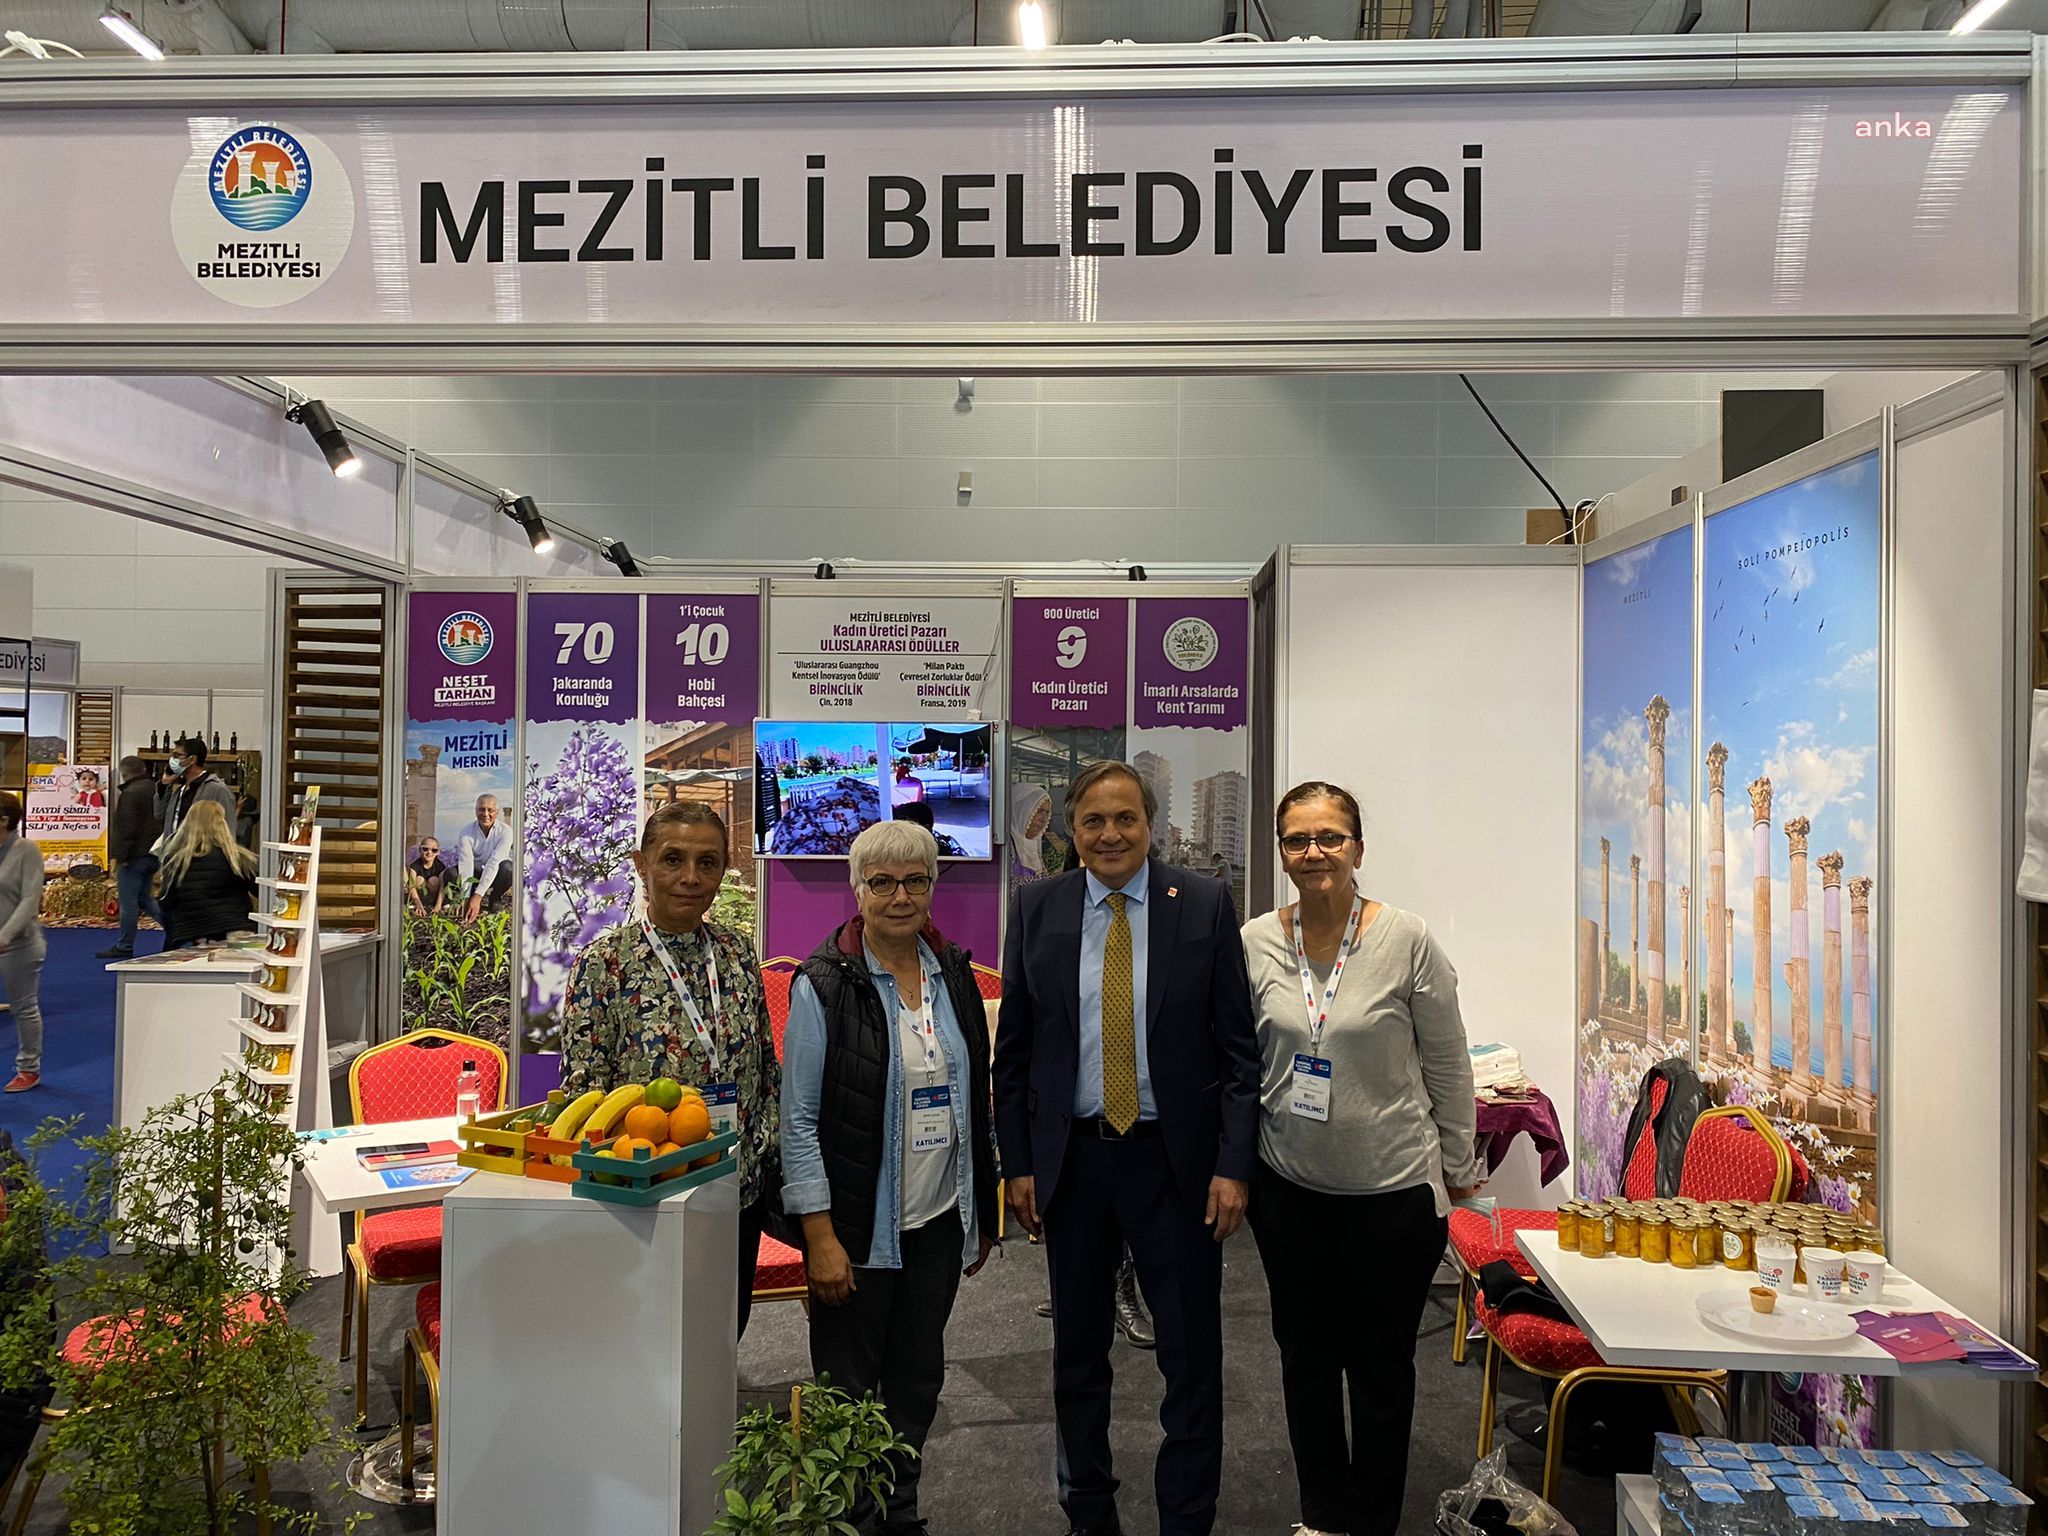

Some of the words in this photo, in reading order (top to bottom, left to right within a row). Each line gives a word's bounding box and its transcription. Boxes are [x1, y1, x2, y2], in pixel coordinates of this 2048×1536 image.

[252, 131, 307, 190] BELEDİYESİ
[420, 154, 826, 264] MEZİTLİ
[867, 143, 1484, 260] BELEDİYESİ
[217, 243, 301, 259] MEZİTLİ
[197, 262, 321, 278] BELEDİYESİ
[1737, 552, 1760, 570] SOLİ
[692, 605, 725, 618] Çocuk
[849, 612, 882, 622] MEZİTLİ
[884, 612, 931, 623] BELEDİYESİ
[1043, 608, 1063, 619] 800
[1064, 607, 1099, 620] Üretici
[833, 624, 867, 637] Kadın
[869, 622, 908, 638] Üretici
[911, 625, 947, 638] Pazarı
[554, 621, 615, 665] 70
[675, 622, 730, 666] 10
[820, 639, 906, 652] ULUSLARARASI
[909, 638, 960, 653] ÖDÜLLER
[1055, 625, 1087, 669] 9
[839, 661, 879, 671] Guangzhou
[946, 662, 965, 670] Paktı
[443, 675, 488, 688] NEŞET
[792, 671, 819, 680] Kentsel
[820, 671, 856, 681] İnovasyon
[899, 672, 930, 682] Çevresel
[931, 673, 964, 681] Zorluklar
[552, 677, 613, 691] Jakaranda
[688, 678, 715, 691] Hobi
[809, 682, 863, 696] BİRİNCİLİK
[917, 683, 971, 697] BİRİNCİLİK
[1032, 681, 1066, 695] Kadın
[1068, 679, 1108, 695] Üretici
[1143, 681, 1179, 698] İmarlı
[1181, 684, 1239, 698] Arsalarda
[438, 688, 492, 700] TARHAN
[556, 693, 609, 708] Koruluğu
[677, 694, 725, 709] Bahçesi
[834, 698, 853, 706] 2018
[947, 699, 967, 708] 2019
[1051, 698, 1088, 711] Pazarı
[1156, 700, 1185, 714] Kent
[1186, 701, 1225, 714] Tarımı
[444, 729, 508, 752] MEZİTLİ
[452, 752, 499, 769] MERSİN
[31, 805, 61, 814] HAYDİ
[63, 805, 90, 815] ŞİMDİ
[62, 822, 88, 831] Nefes
[1294, 1102, 1325, 1114] KATILIMCI
[915, 1136, 947, 1147] KATILIMCI
